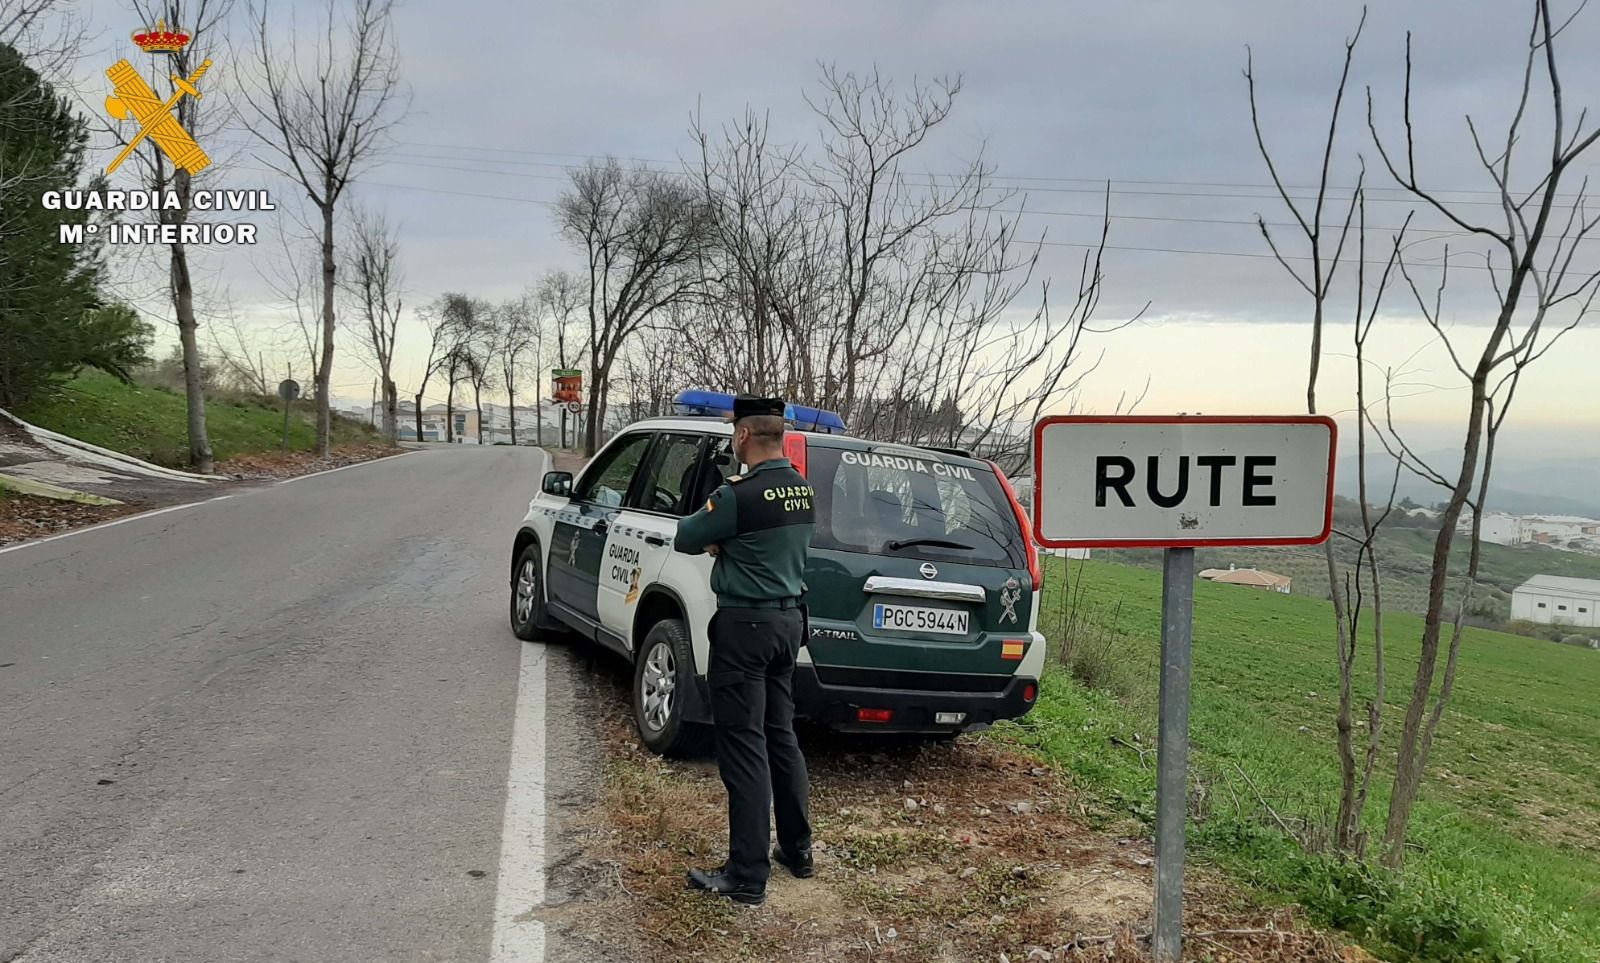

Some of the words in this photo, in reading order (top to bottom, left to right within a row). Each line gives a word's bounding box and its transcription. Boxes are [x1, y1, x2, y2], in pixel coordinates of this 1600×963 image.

[841, 451, 929, 474] GUARDIA
[932, 463, 977, 482] CIVIL
[1095, 455, 1277, 508] RUTE
[784, 498, 811, 511] CIVIL
[609, 543, 640, 566] GUARDIA
[611, 565, 629, 584] CIVIL
[883, 607, 968, 632] PGC5944N
[811, 628, 858, 641] X-TRAIL
